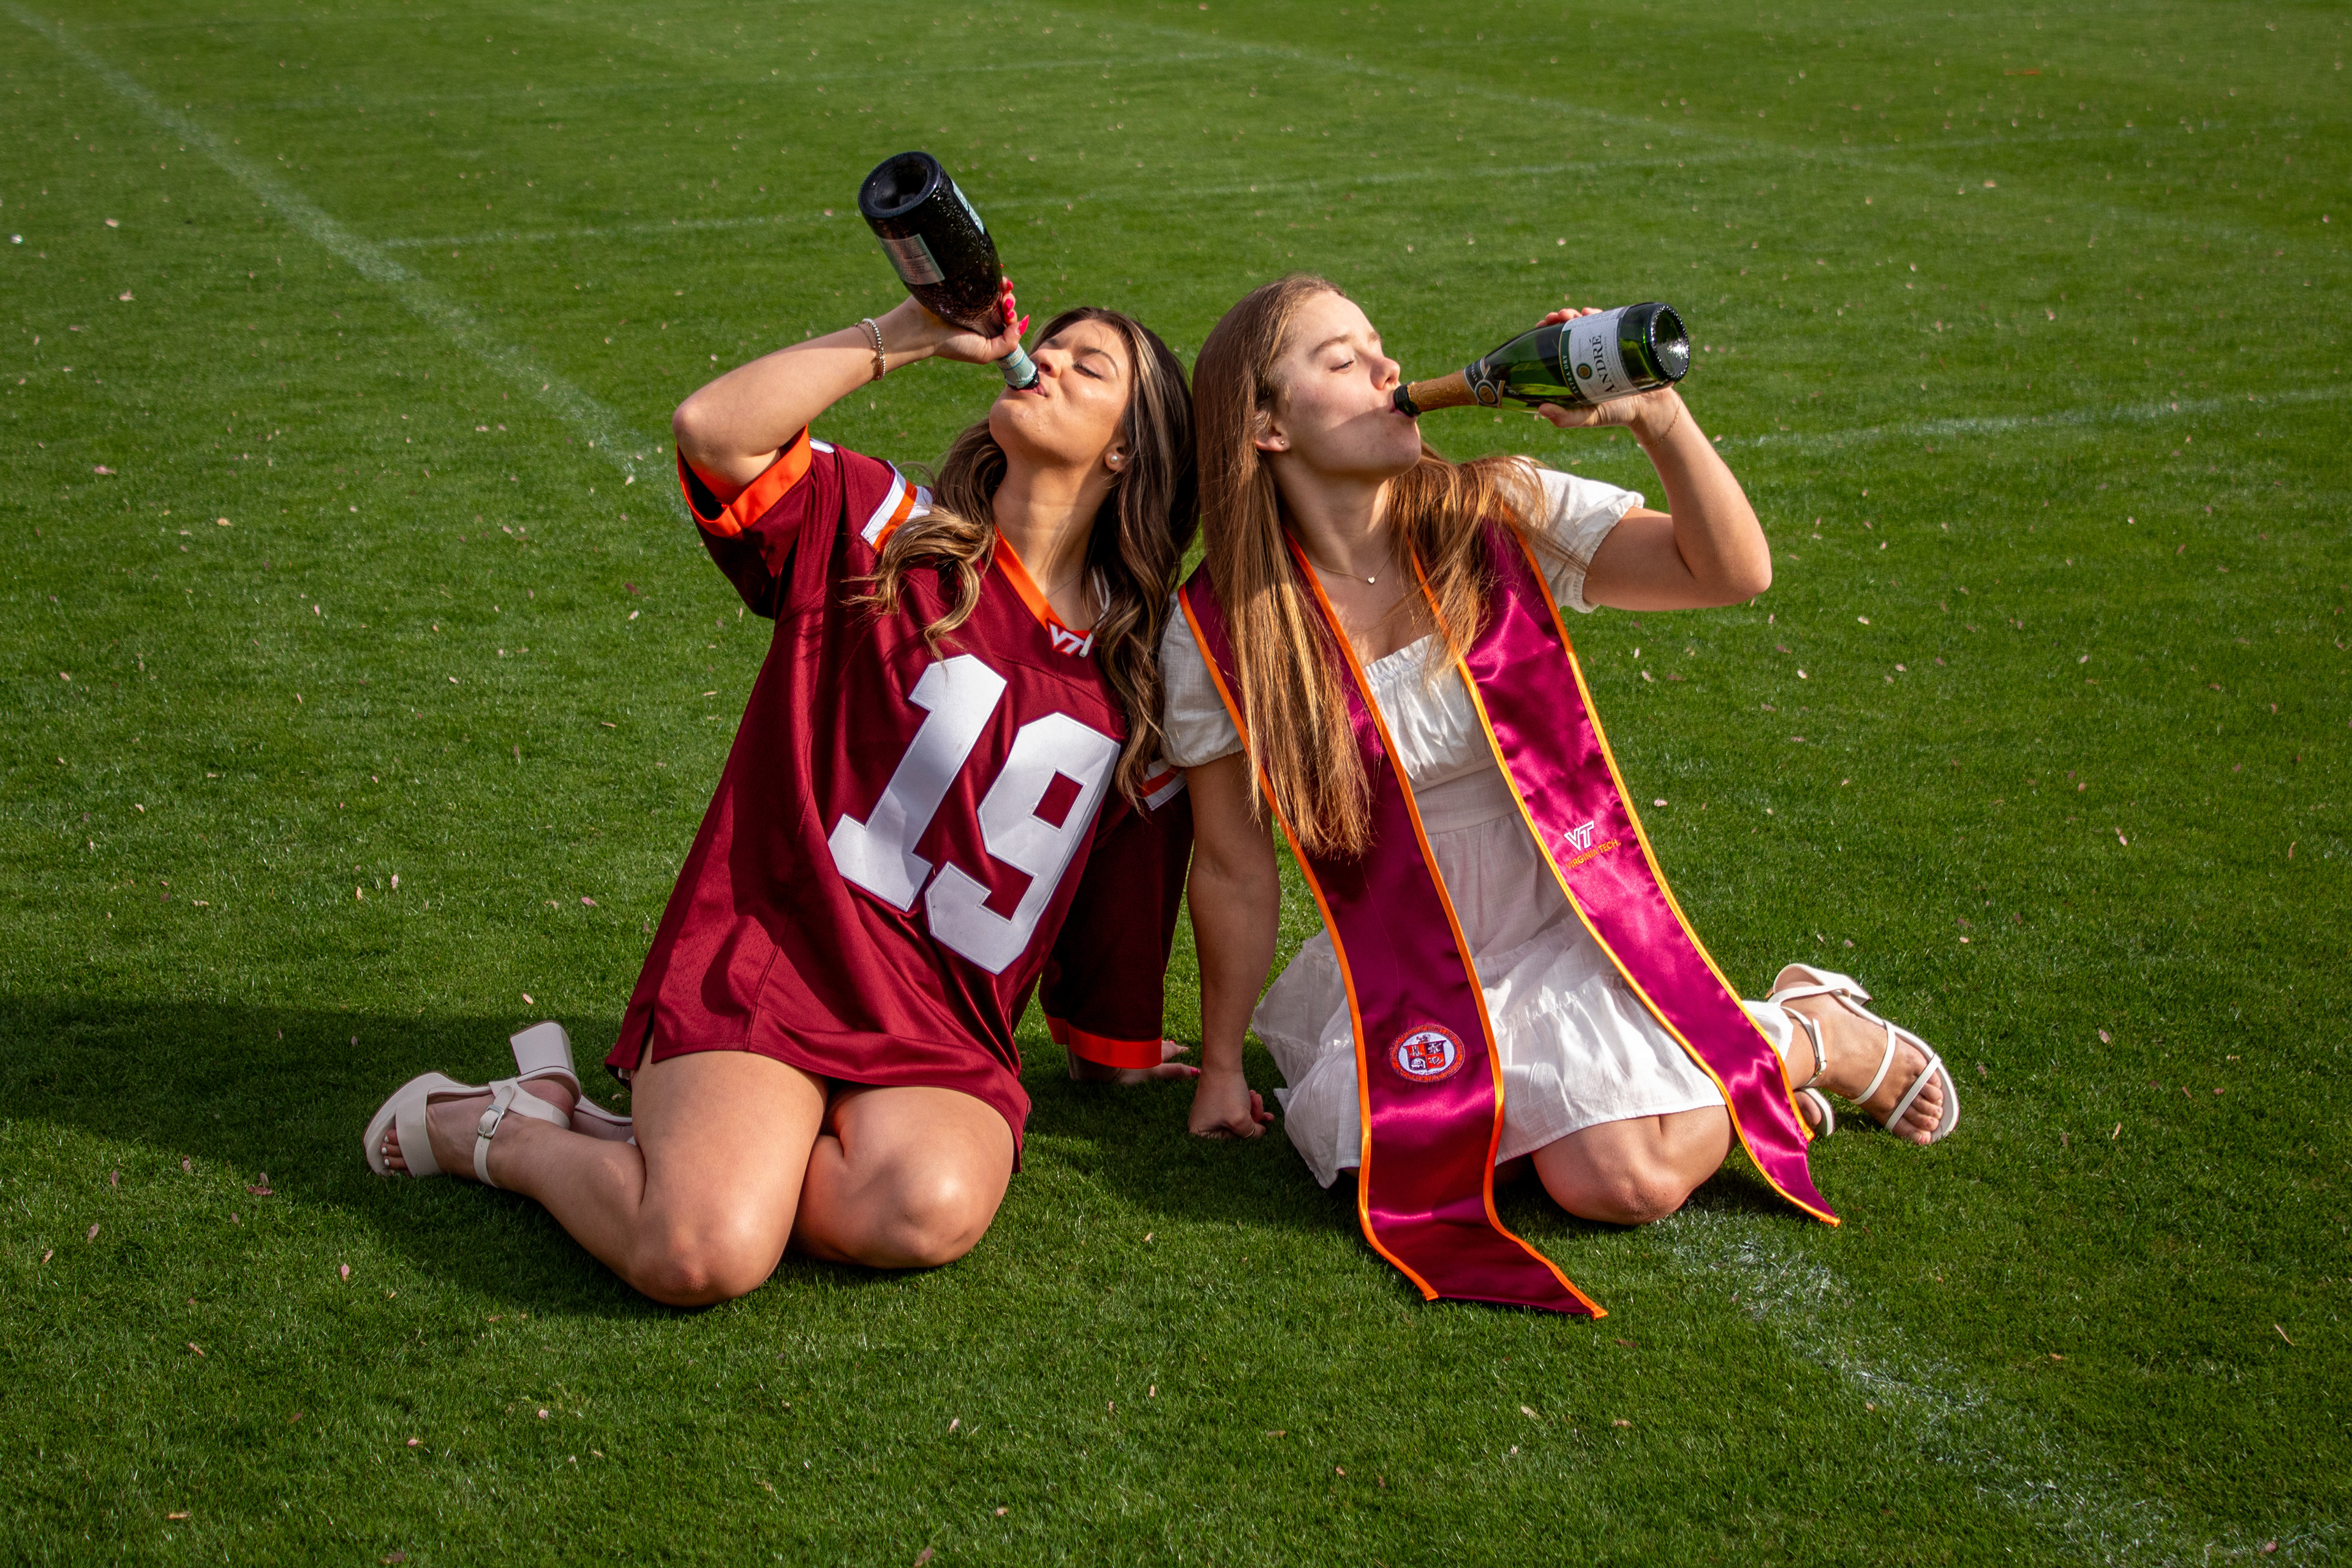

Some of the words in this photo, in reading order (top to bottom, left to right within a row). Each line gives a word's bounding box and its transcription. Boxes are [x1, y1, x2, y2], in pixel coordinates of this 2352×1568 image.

[1589, 335, 1619, 392] ANDRÉ
[1564, 373, 1578, 394] EXTRA
[1049, 624, 1085, 655] VT
[827, 654, 1121, 975] 19
[1564, 820, 1594, 851] VT
[1565, 848, 1599, 869] VIRGINIA
